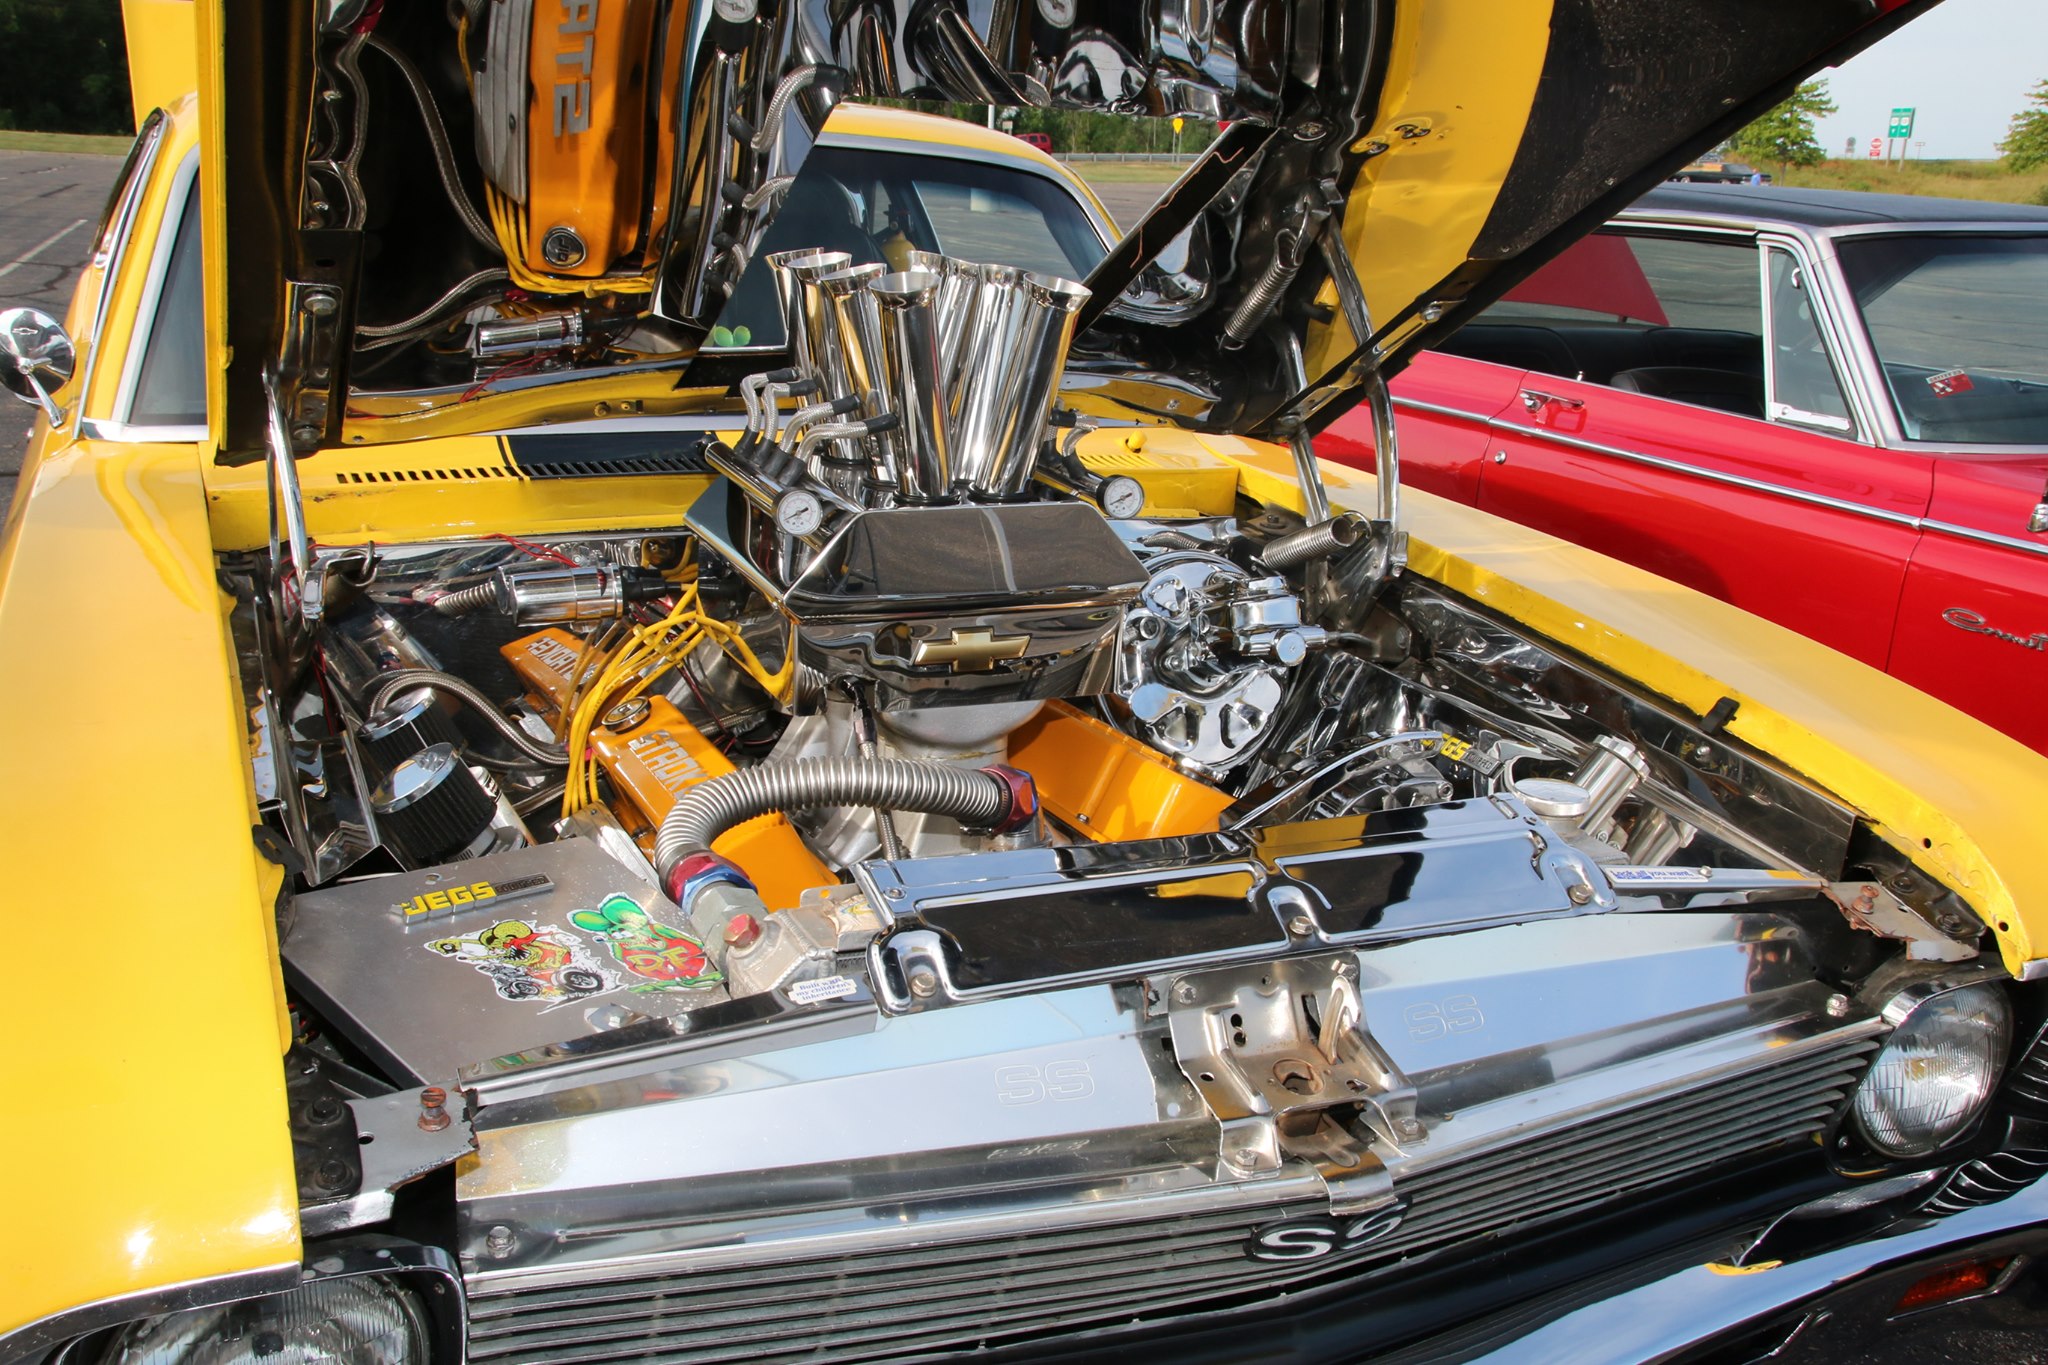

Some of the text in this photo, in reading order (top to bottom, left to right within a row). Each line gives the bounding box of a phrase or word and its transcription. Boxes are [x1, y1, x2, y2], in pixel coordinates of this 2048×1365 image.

[627, 729, 708, 800] STROK
[401, 880, 497, 917] JEGS
[1402, 993, 1485, 1042] SS
[994, 1059, 1095, 1107] SS
[1252, 1203, 1409, 1261] SS
